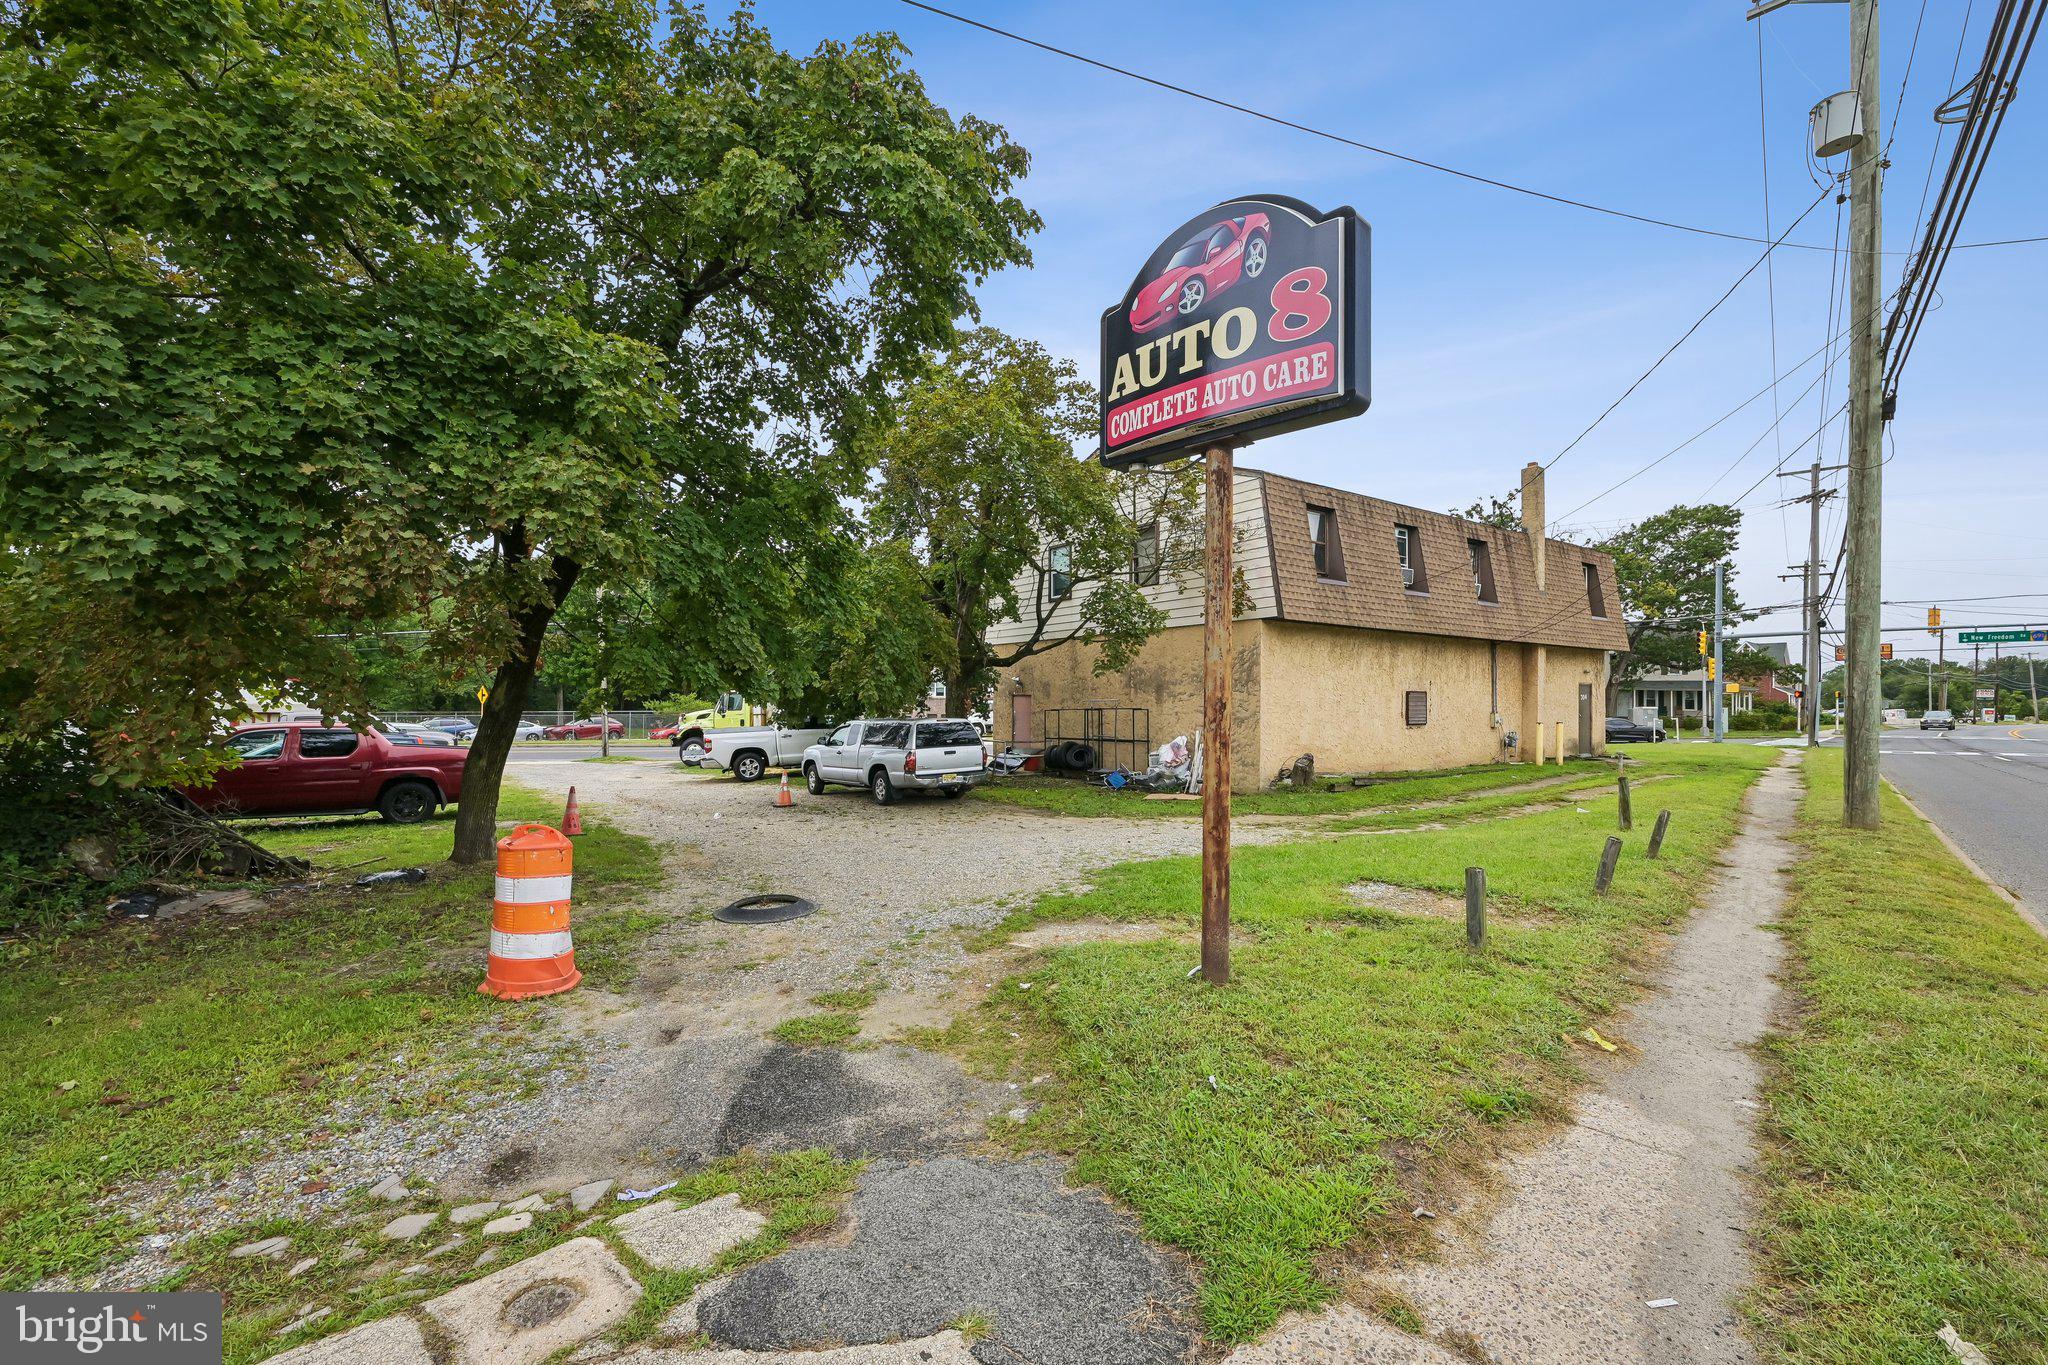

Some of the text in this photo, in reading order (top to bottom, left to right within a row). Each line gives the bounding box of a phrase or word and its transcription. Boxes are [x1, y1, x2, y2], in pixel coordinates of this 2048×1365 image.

[1108, 266, 1332, 403] AUTO 8
[1110, 351, 1328, 439] COMPLETE AUTO CARE
